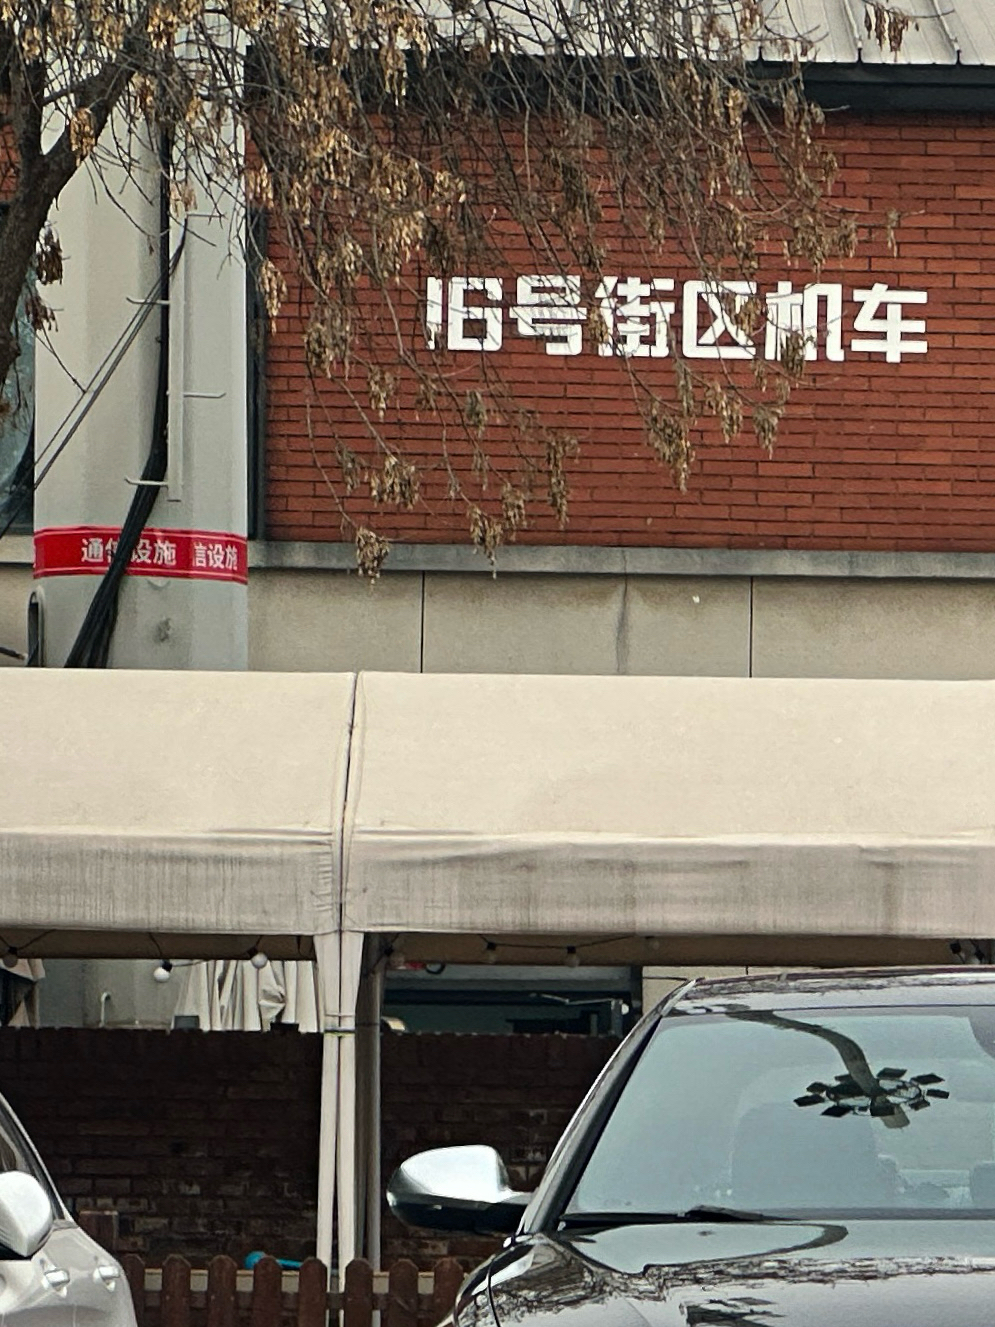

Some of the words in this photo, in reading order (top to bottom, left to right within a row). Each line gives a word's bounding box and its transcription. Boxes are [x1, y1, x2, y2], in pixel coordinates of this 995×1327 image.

[426, 274, 928, 363] 16号街区机车
